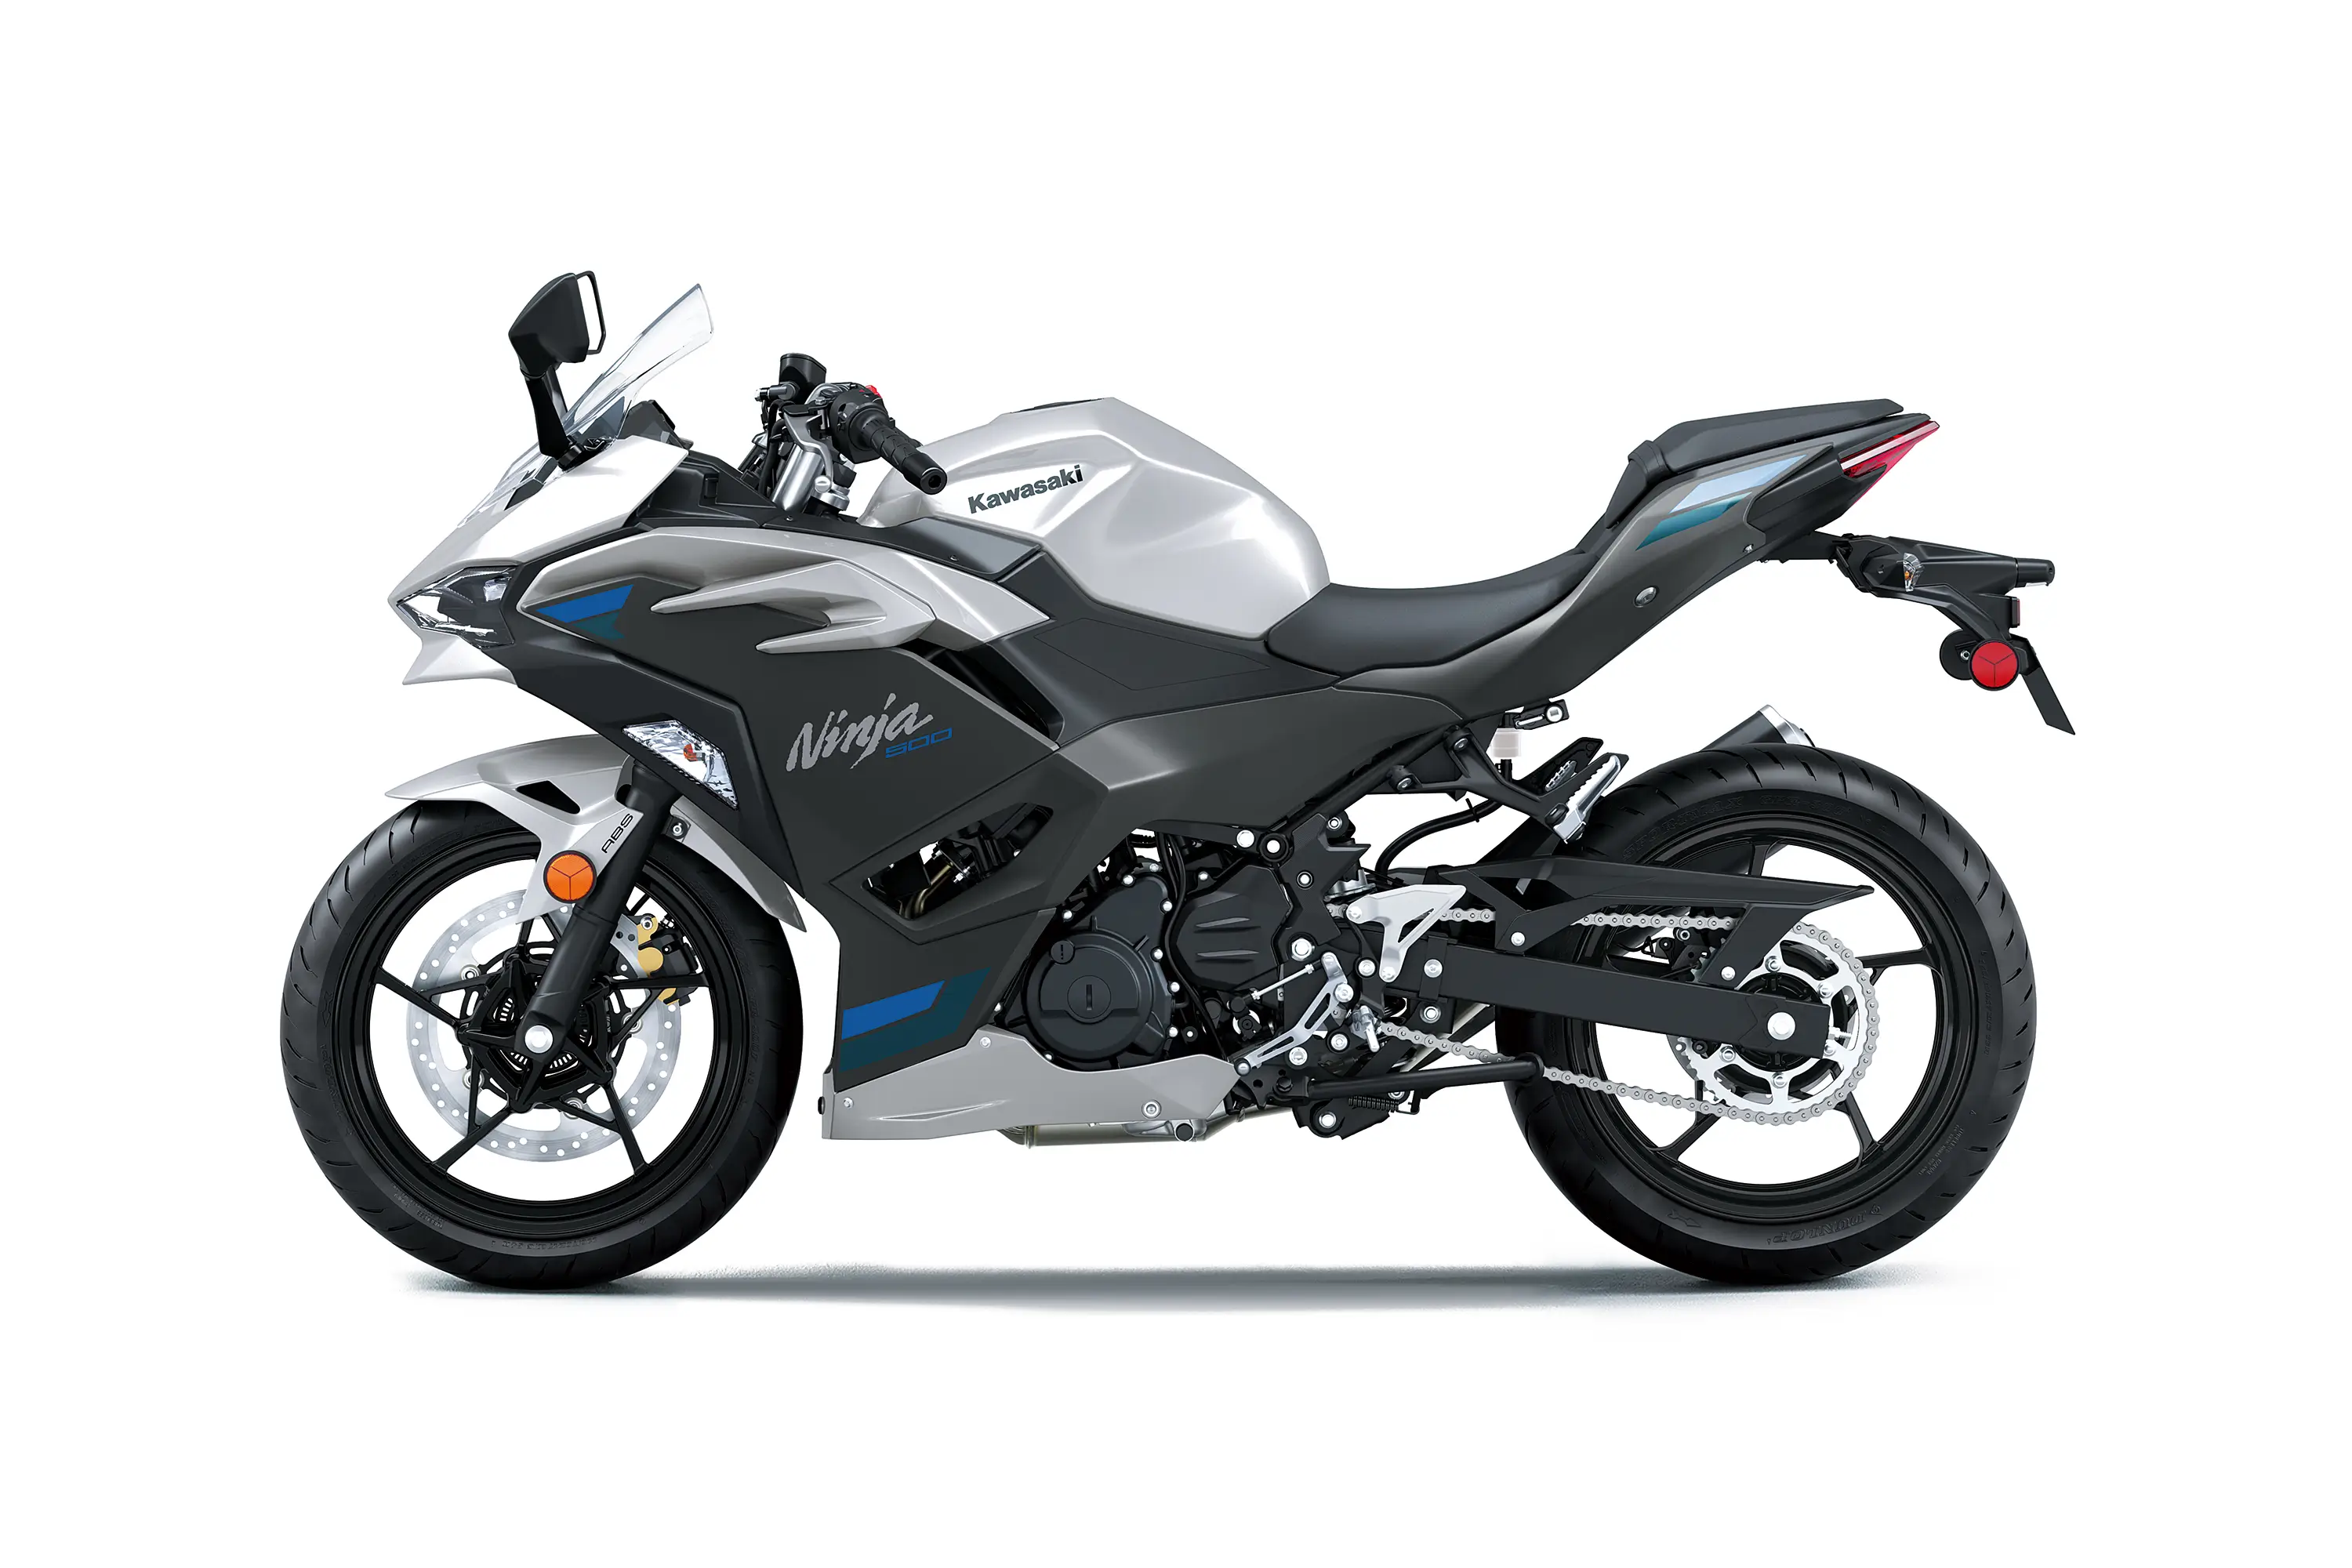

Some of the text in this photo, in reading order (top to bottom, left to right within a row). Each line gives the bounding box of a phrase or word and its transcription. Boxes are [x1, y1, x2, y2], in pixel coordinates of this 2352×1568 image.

[968, 464, 1083, 514] Kawasaki
[786, 693, 953, 771] Ninja 500
[601, 813, 633, 853] ABS
